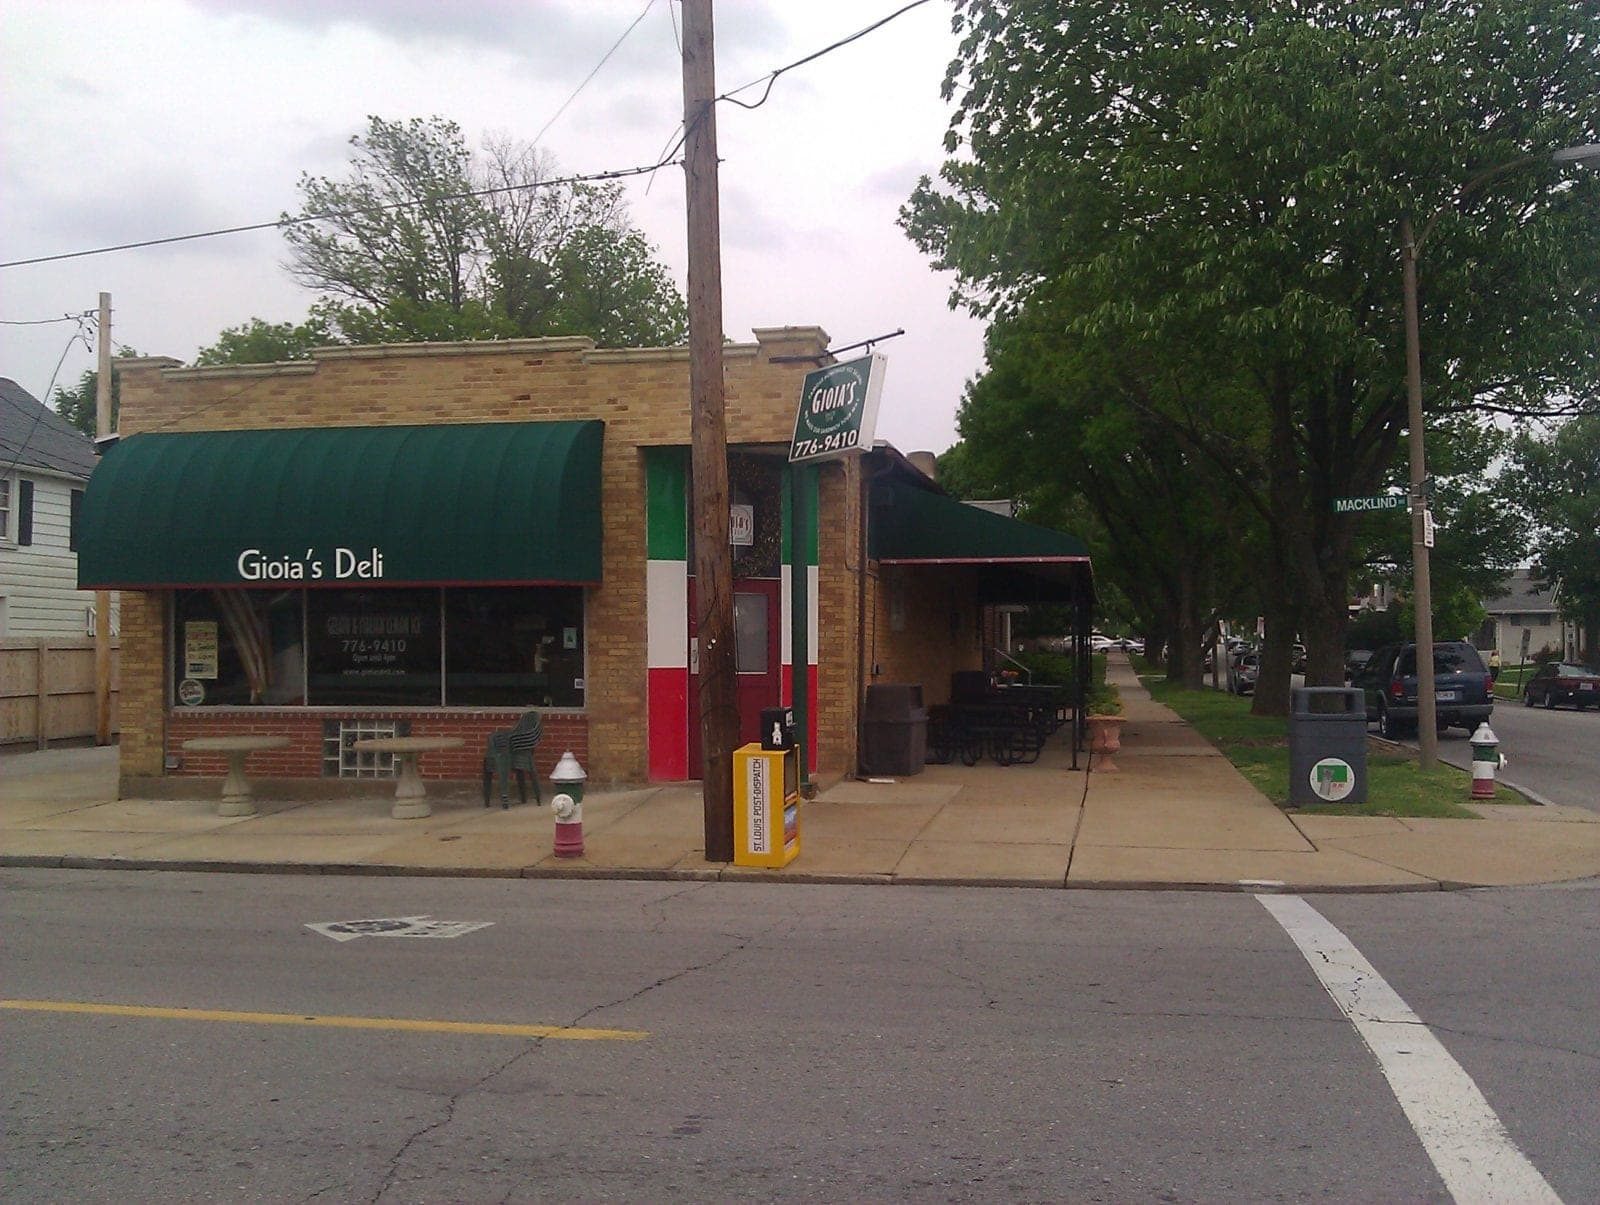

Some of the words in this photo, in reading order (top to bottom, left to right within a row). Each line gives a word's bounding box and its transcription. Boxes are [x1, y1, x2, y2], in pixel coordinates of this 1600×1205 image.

[812, 380, 857, 414] GIOIA'S
[795, 429, 857, 458] 776-9410
[1336, 497, 1397, 512] MACKLIND
[237, 549, 323, 580] Gioia's
[335, 548, 384, 579] Deli
[342, 640, 406, 652] 776-9410
[753, 758, 762, 817] POST-DISPATCH
[753, 818, 762, 841] LOUIS
